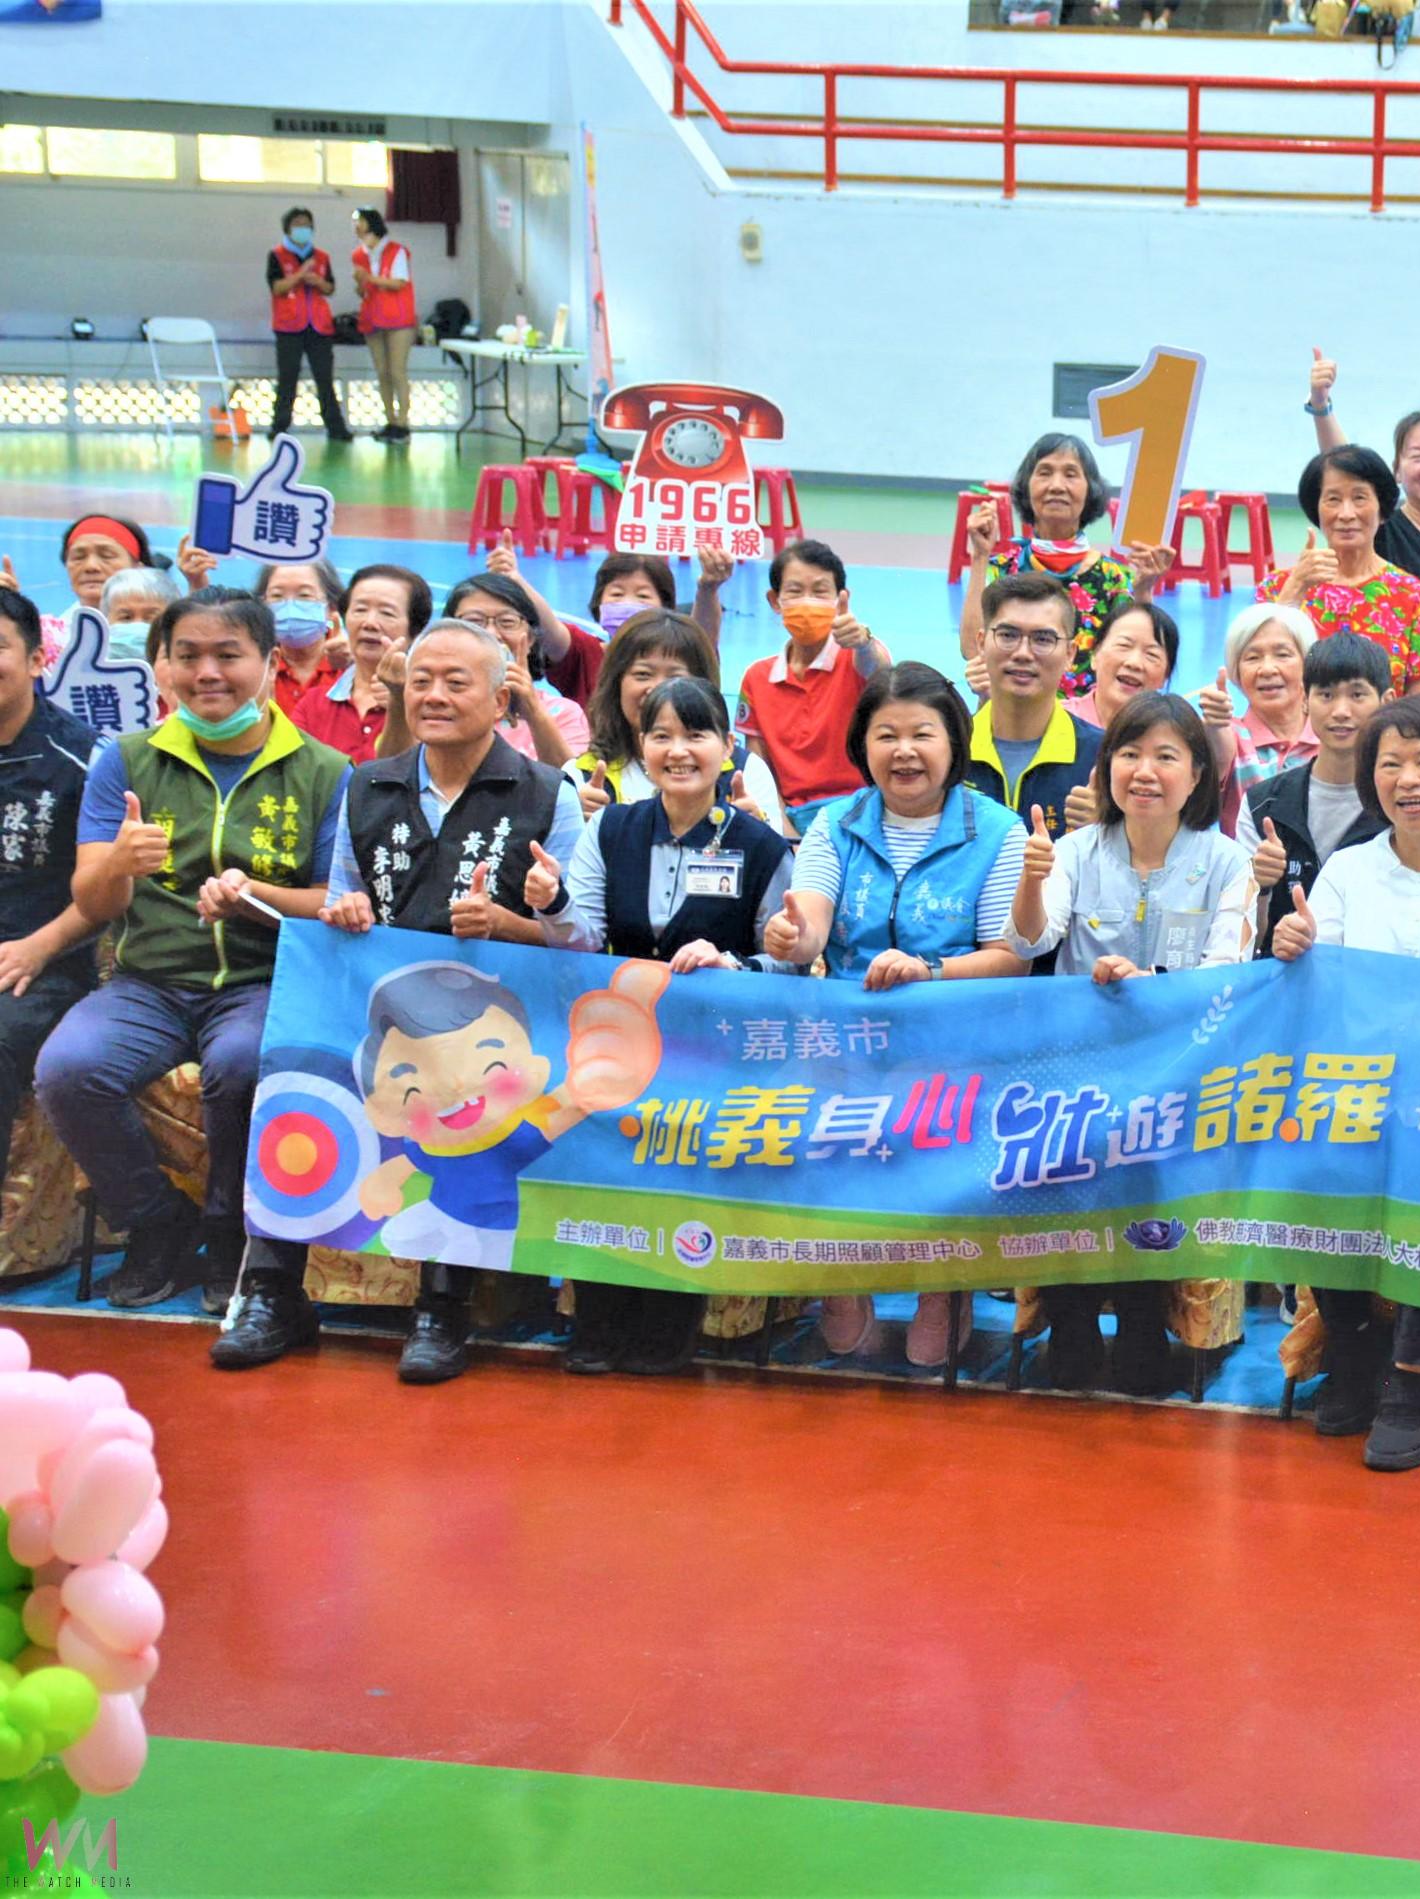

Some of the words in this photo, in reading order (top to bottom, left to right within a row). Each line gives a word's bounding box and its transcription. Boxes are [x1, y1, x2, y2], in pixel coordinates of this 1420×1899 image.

[1094, 350, 1200, 548] 1
[253, 499, 300, 547] 讚
[628, 482, 751, 525] 1966
[619, 523, 761, 556] 申請專線
[69, 684, 123, 731] 讚
[484, 816, 513, 899] 嘉義市議
[740, 1017, 892, 1062] 嘉義市
[556, 1220, 649, 1251] 主辦單位
[722, 1236, 983, 1263] 嘉義市長期照顧管理中心
[1000, 1230, 1099, 1257] 協辦單位
